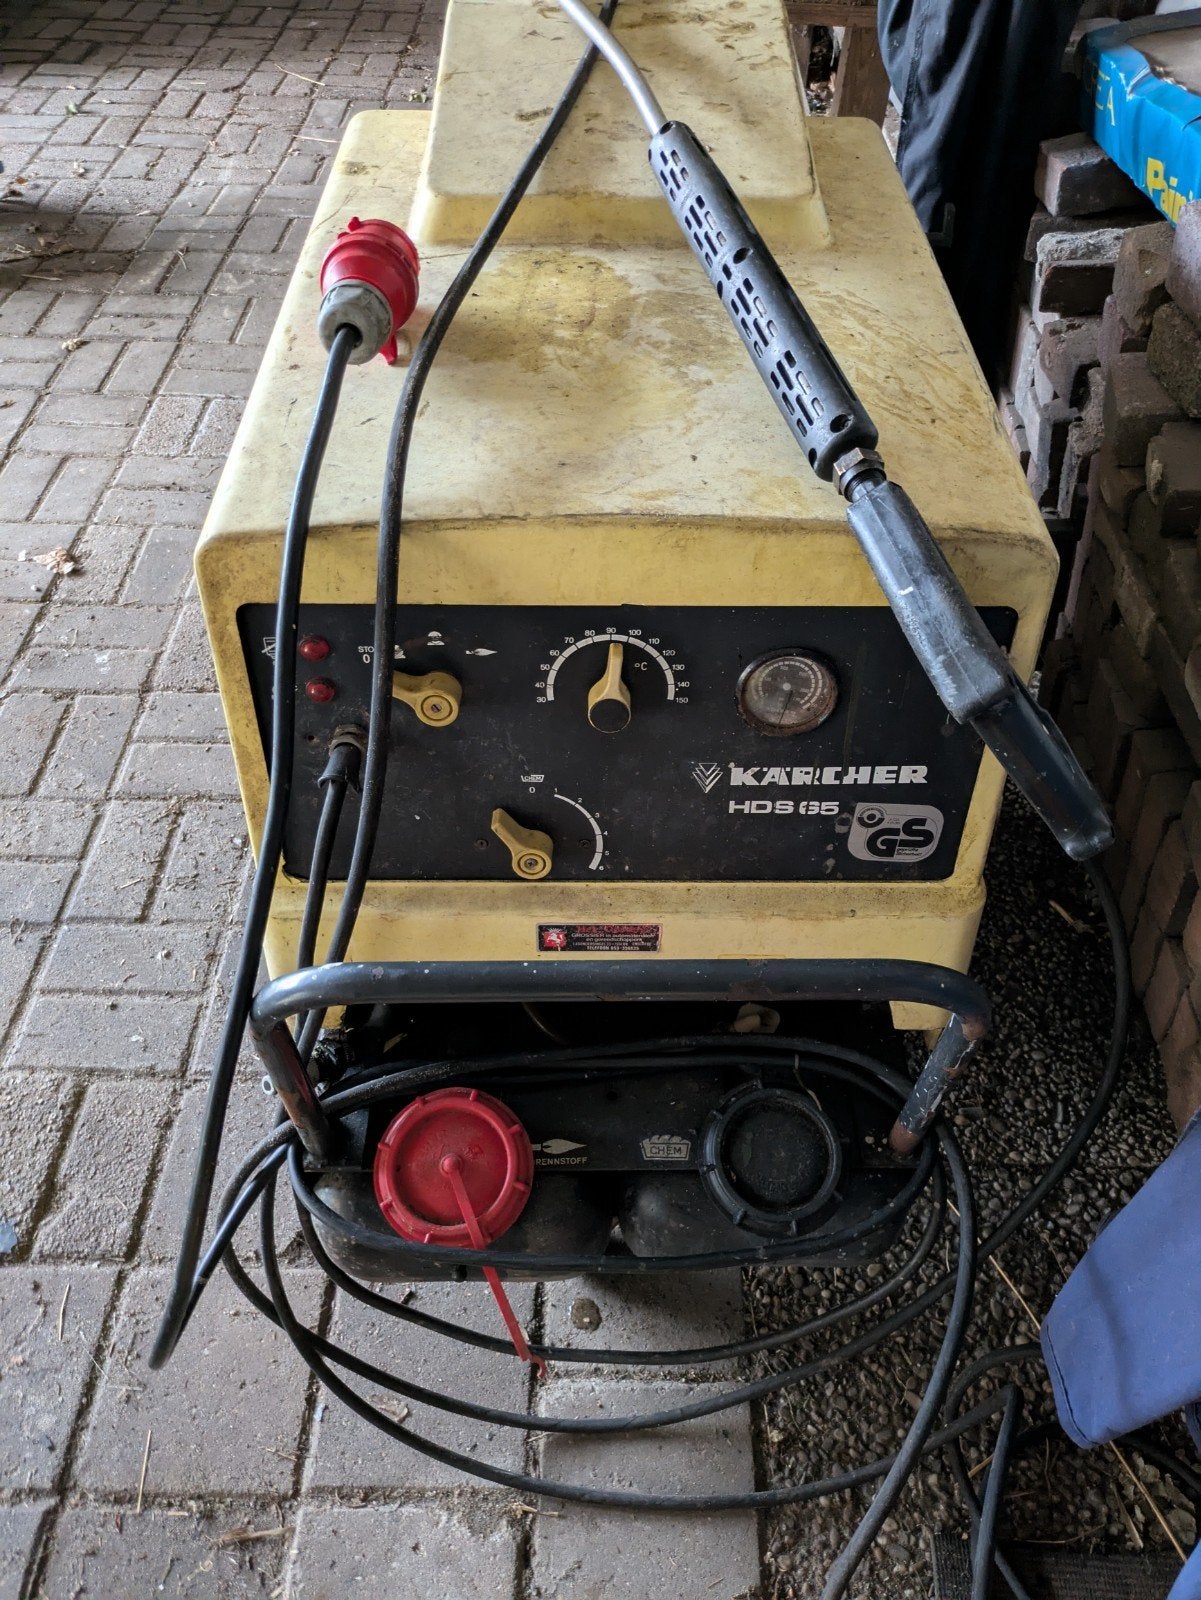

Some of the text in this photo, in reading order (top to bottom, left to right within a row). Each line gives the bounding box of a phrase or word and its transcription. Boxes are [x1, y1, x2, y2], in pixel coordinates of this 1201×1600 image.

[648, 637, 660, 645] 110
[728, 800, 795, 814] HDS
[867, 817, 935, 858] GS
[649, 1145, 683, 1155] CHEM
[535, 1156, 588, 1166] RENNSTOFF
